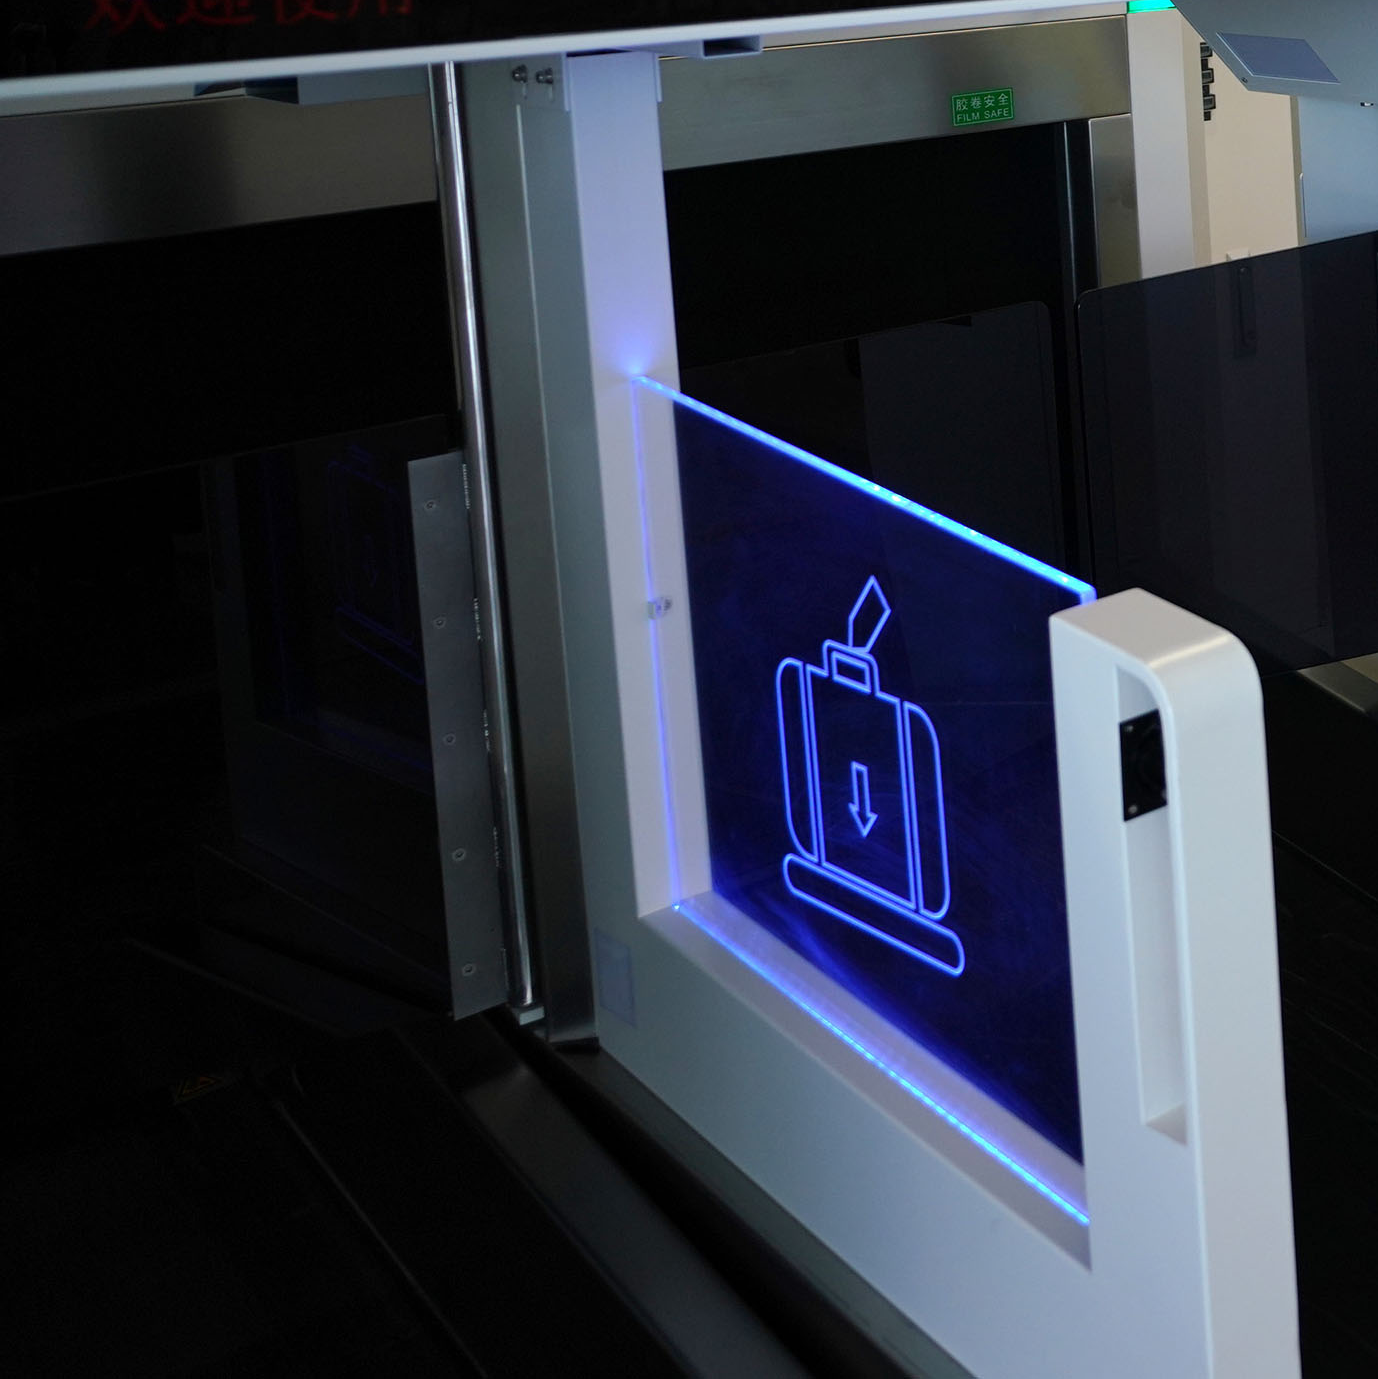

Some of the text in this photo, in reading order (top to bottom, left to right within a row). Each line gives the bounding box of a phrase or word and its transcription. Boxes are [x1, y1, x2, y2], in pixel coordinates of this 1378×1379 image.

[955, 92, 1010, 112] 胶卷安全
[956, 107, 1010, 123] FILM SAFE
